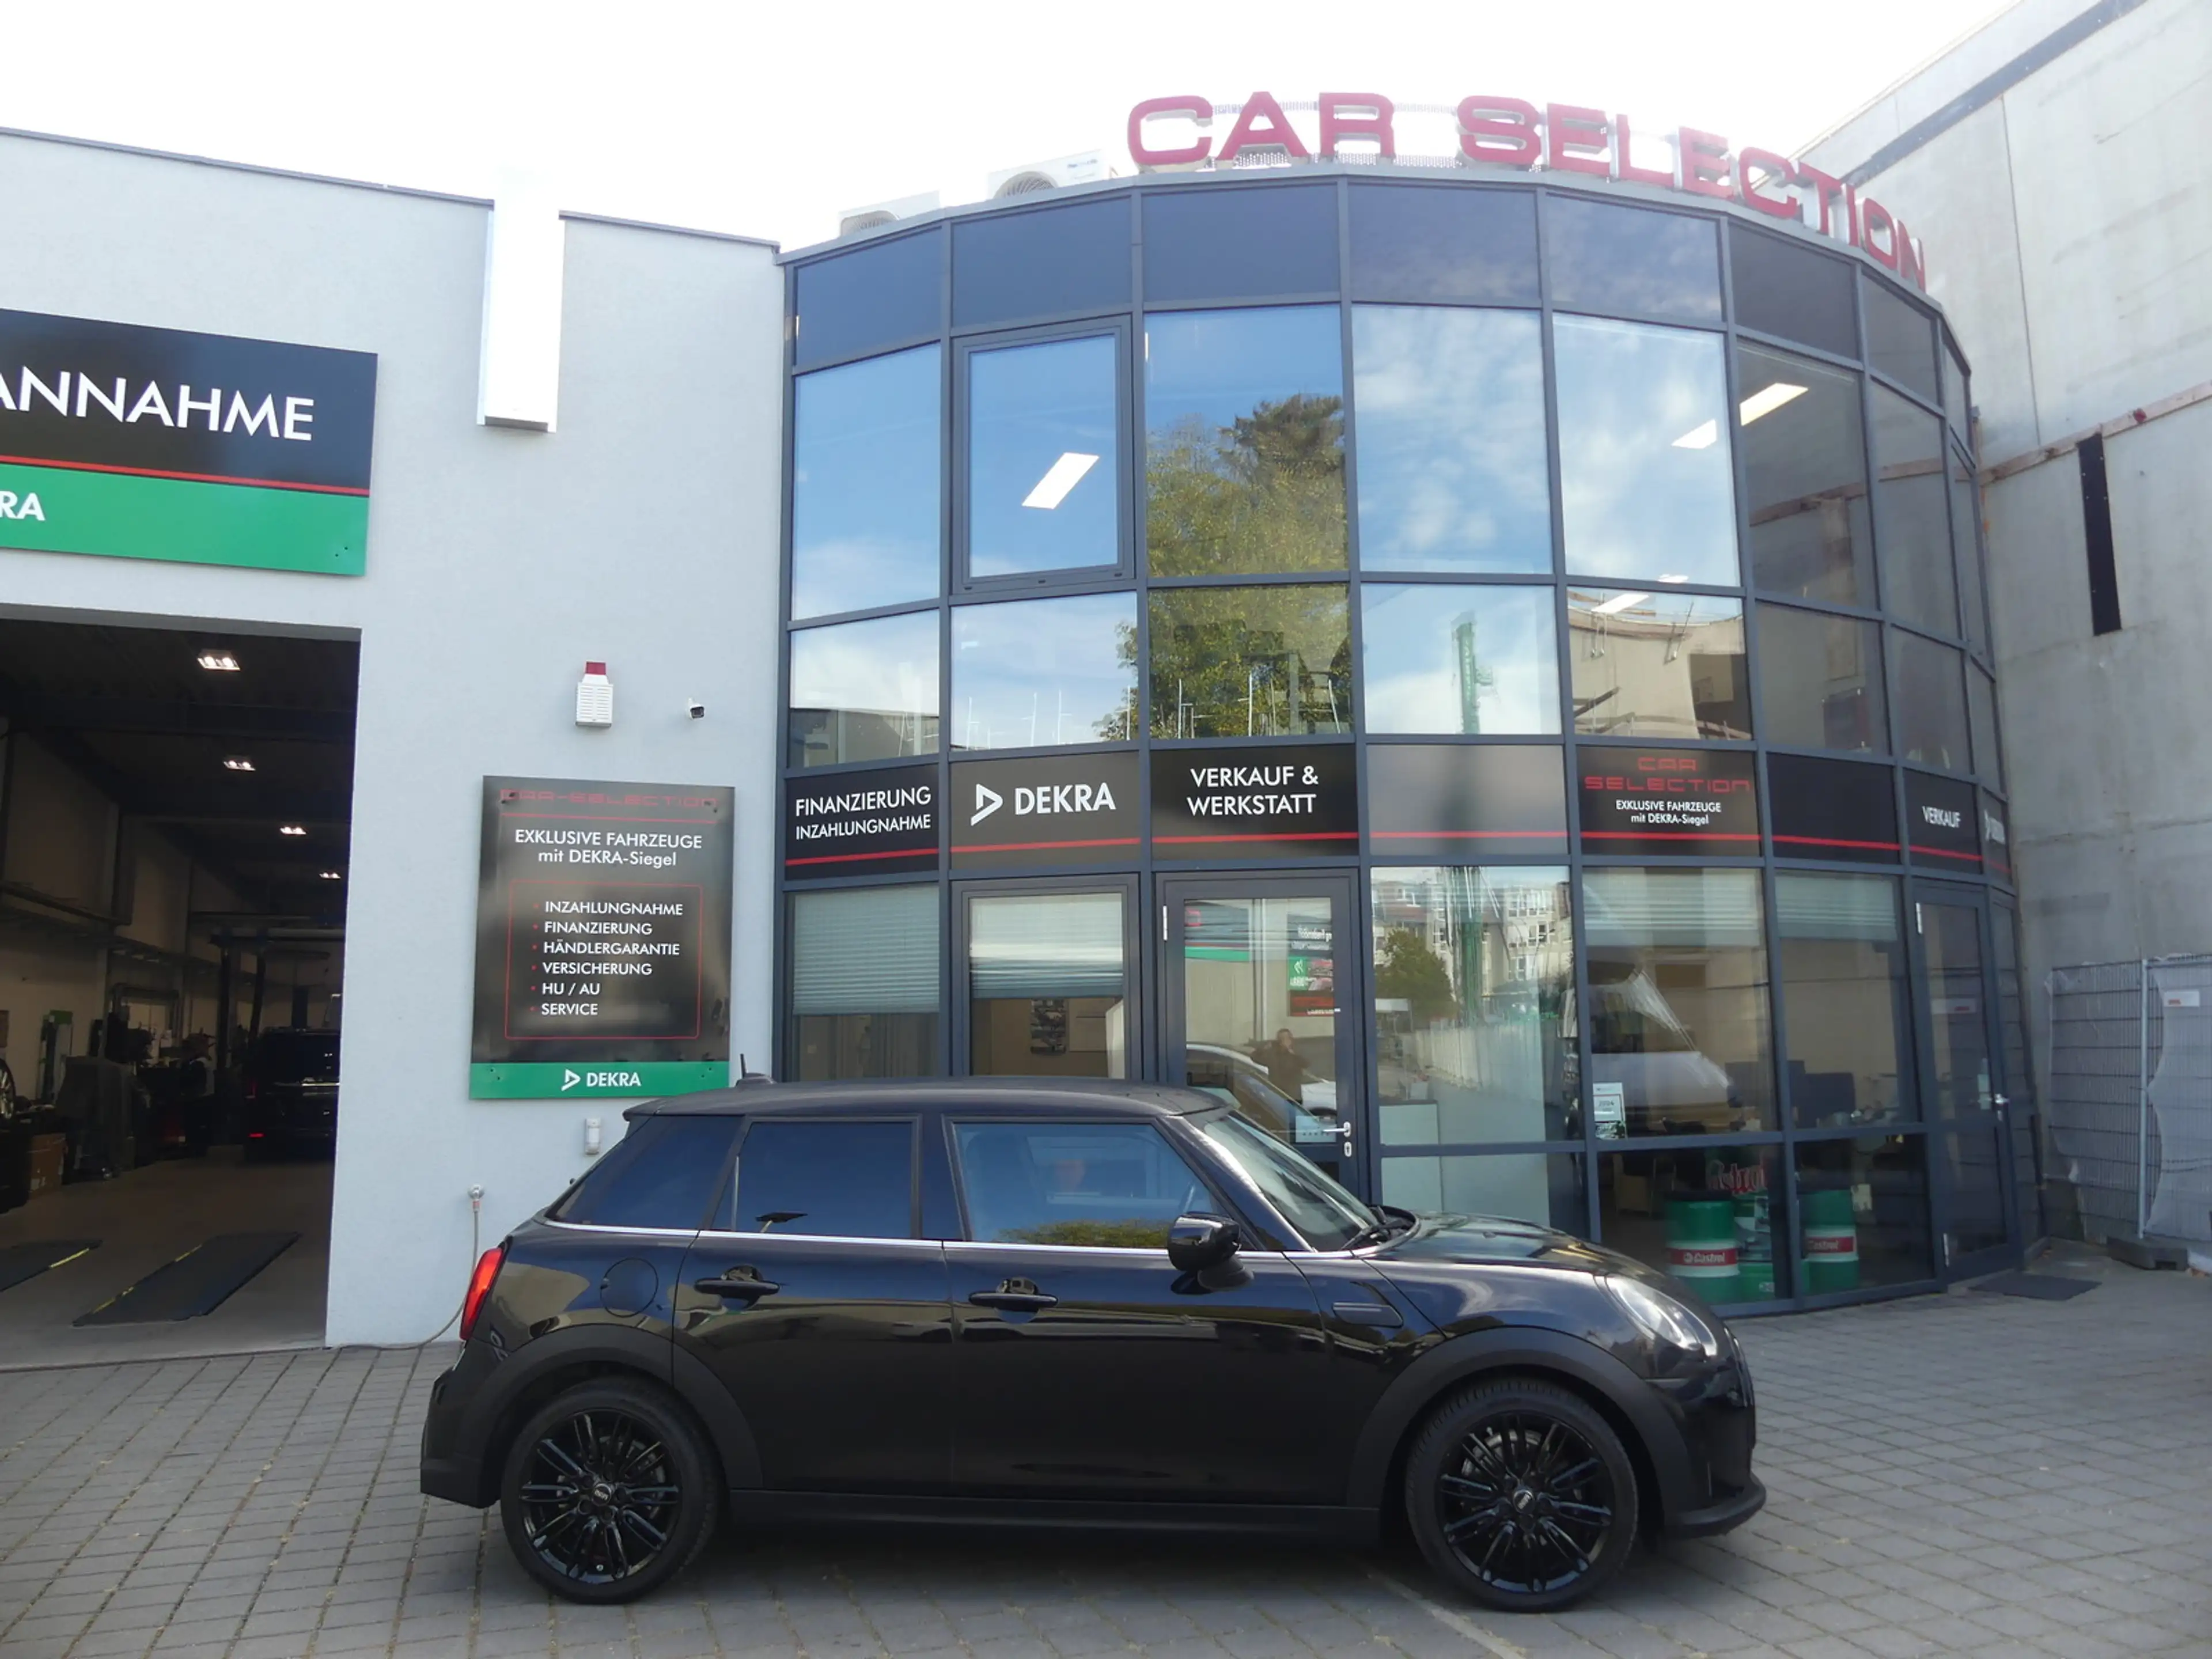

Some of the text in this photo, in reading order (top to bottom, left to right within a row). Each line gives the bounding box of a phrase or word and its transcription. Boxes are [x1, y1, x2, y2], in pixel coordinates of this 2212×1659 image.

[1127, 91, 1926, 294] CAR SELECTION
[1638, 757, 1697, 770] CAR
[1190, 766, 1319, 787] VERKAUF &
[1585, 776, 1749, 793] SELECTION
[796, 786, 931, 816] FINANZIERUNG
[1014, 782, 1116, 816] DEKRA
[1187, 794, 1317, 816] WERKSTATT
[1616, 800, 1721, 813] EXKLUSIVE FAHRZEUGE
[1631, 813, 1709, 826] mit DEKRA-Siegel
[1922, 806, 1961, 828] VERKAUF
[796, 814, 931, 840] INZAHLUNGNAHME
[516, 829, 702, 849] EXKLUSIVE FAHRZEUGE
[538, 849, 677, 869] mit DEKRA-Siegel
[545, 901, 683, 916] INZAHLUNGNAHME
[544, 921, 653, 935] FINANZIERUNG
[544, 939, 680, 956] HÄNDLERGARANTIE
[543, 962, 653, 976] VERSICHERUNG
[542, 983, 600, 996] HU / AU
[541, 1003, 598, 1016] SERVICE
[586, 1072, 642, 1088] DEKRA
